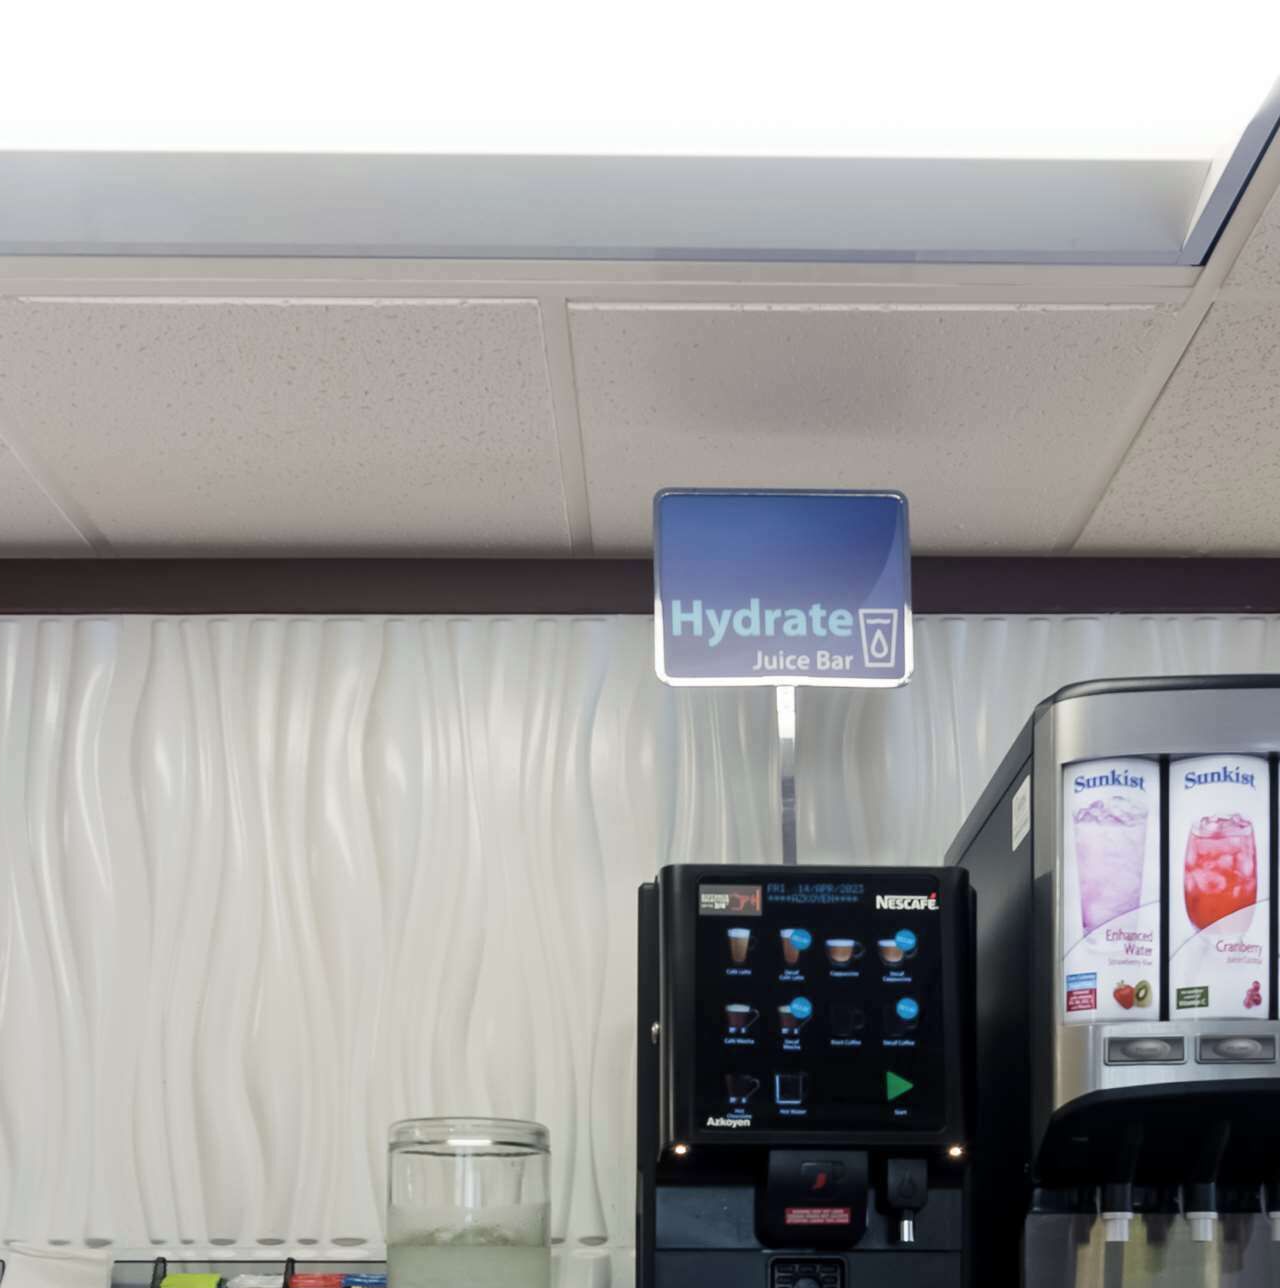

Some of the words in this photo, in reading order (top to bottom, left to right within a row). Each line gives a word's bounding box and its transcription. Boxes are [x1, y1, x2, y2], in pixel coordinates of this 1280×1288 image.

[671, 598, 854, 647] Hydrate
[752, 650, 810, 671] Juice
[816, 651, 853, 670] Bar
[1074, 769, 1146, 793] Sunkist
[1184, 766, 1256, 790] Sunkist
[1105, 929, 1153, 943] Enhanced
[1124, 944, 1153, 957] Water
[1216, 938, 1263, 957] Cranberry
[706, 1116, 752, 1129] Azkoyen
